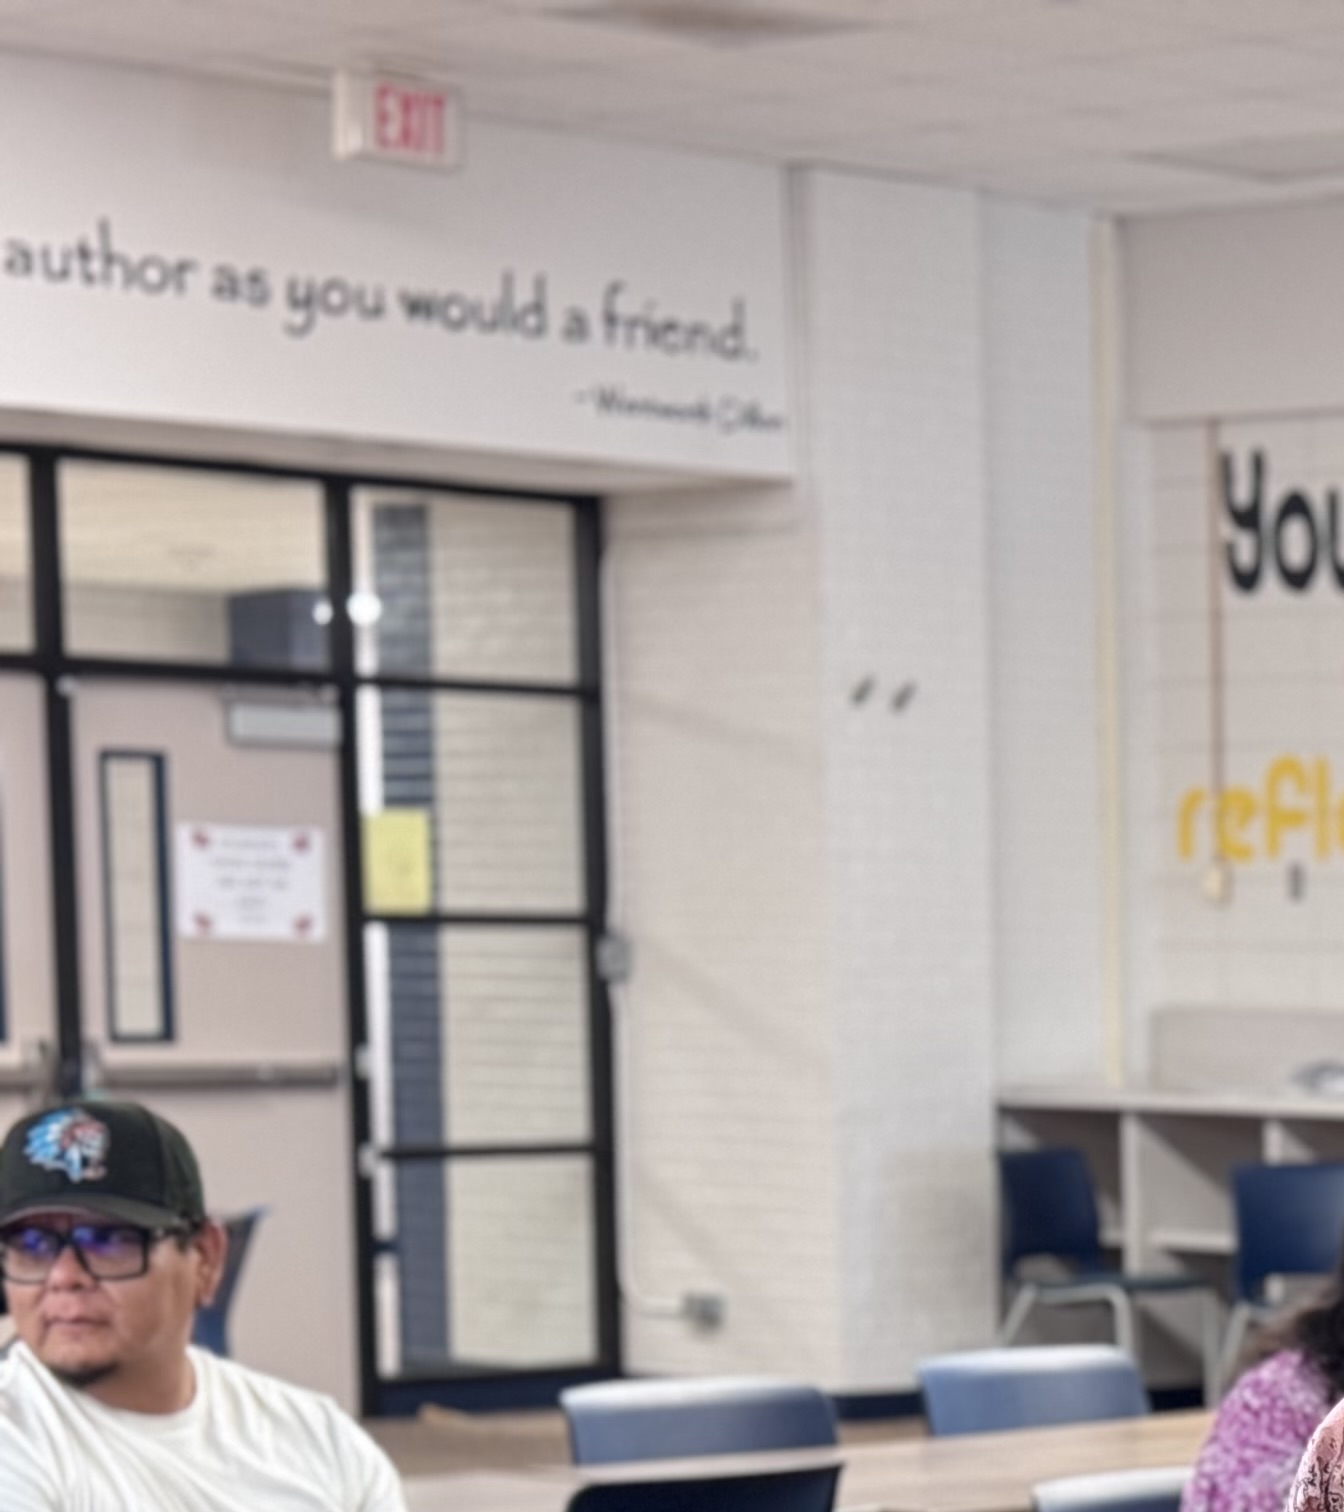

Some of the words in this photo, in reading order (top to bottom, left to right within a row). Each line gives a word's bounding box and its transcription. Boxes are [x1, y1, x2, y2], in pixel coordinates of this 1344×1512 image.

[373, 84, 446, 156] EXIT
[3, 215, 200, 295] author
[211, 264, 270, 307] as
[284, 276, 386, 338] you
[400, 269, 547, 340] would
[560, 304, 591, 344] a
[602, 279, 758, 362] friend.
